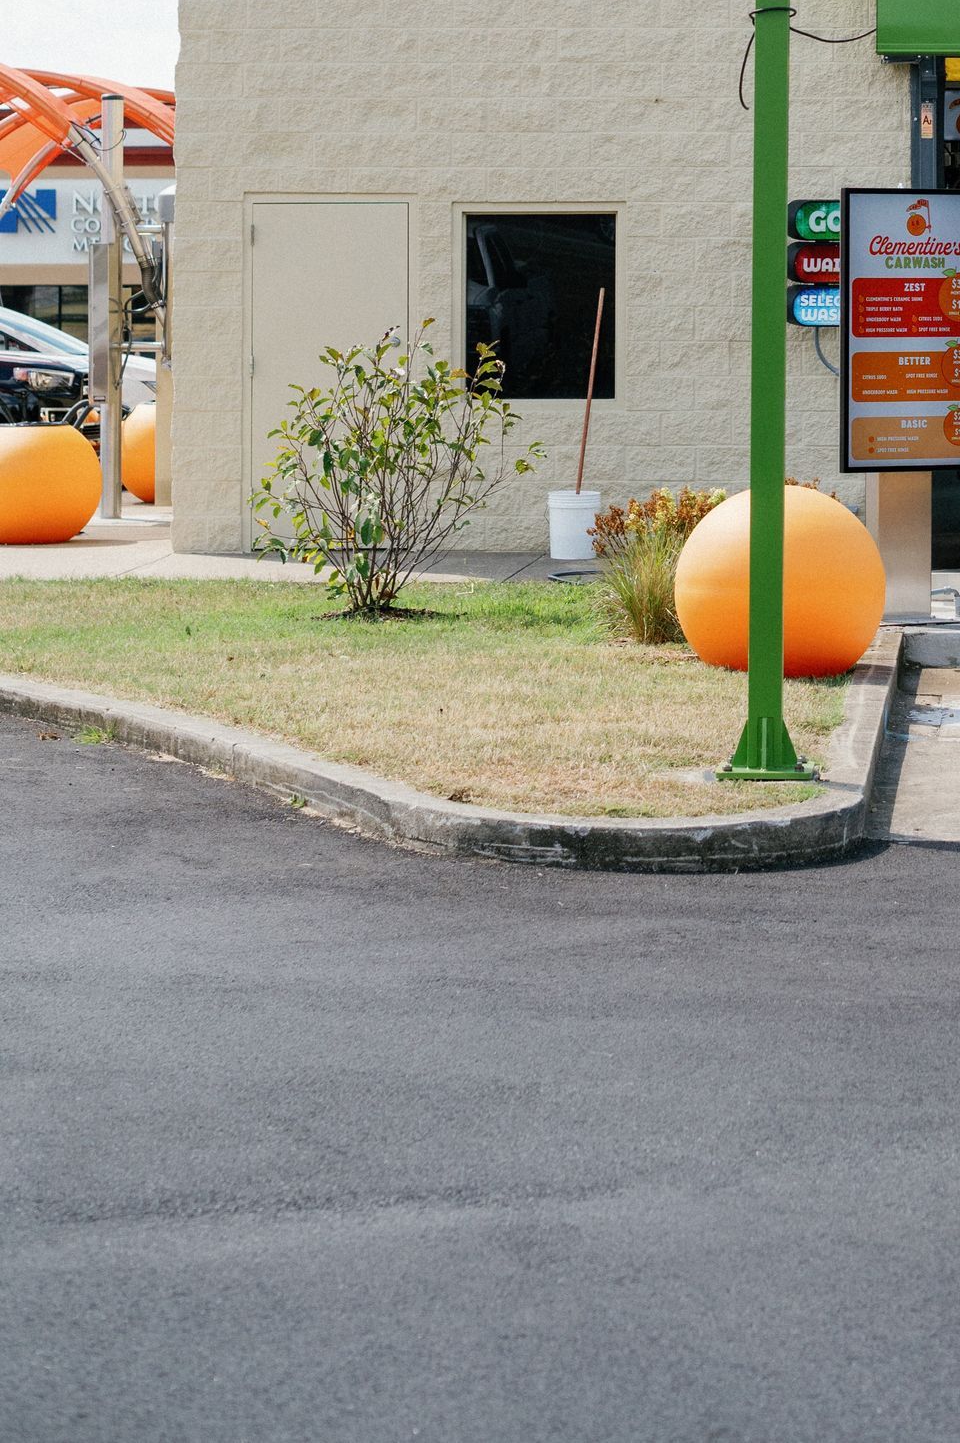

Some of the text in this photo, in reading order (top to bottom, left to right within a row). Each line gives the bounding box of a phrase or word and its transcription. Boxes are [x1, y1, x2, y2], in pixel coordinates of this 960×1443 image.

[808, 210, 840, 233] GO
[803, 258, 840, 272] WAI
[885, 256, 945, 269] CARWASH
[904, 283, 926, 292] ZEST
[800, 294, 840, 306] SELEC
[801, 308, 840, 322] WAS
[898, 357, 930, 366] BETTER
[901, 420, 928, 428] BASIC
